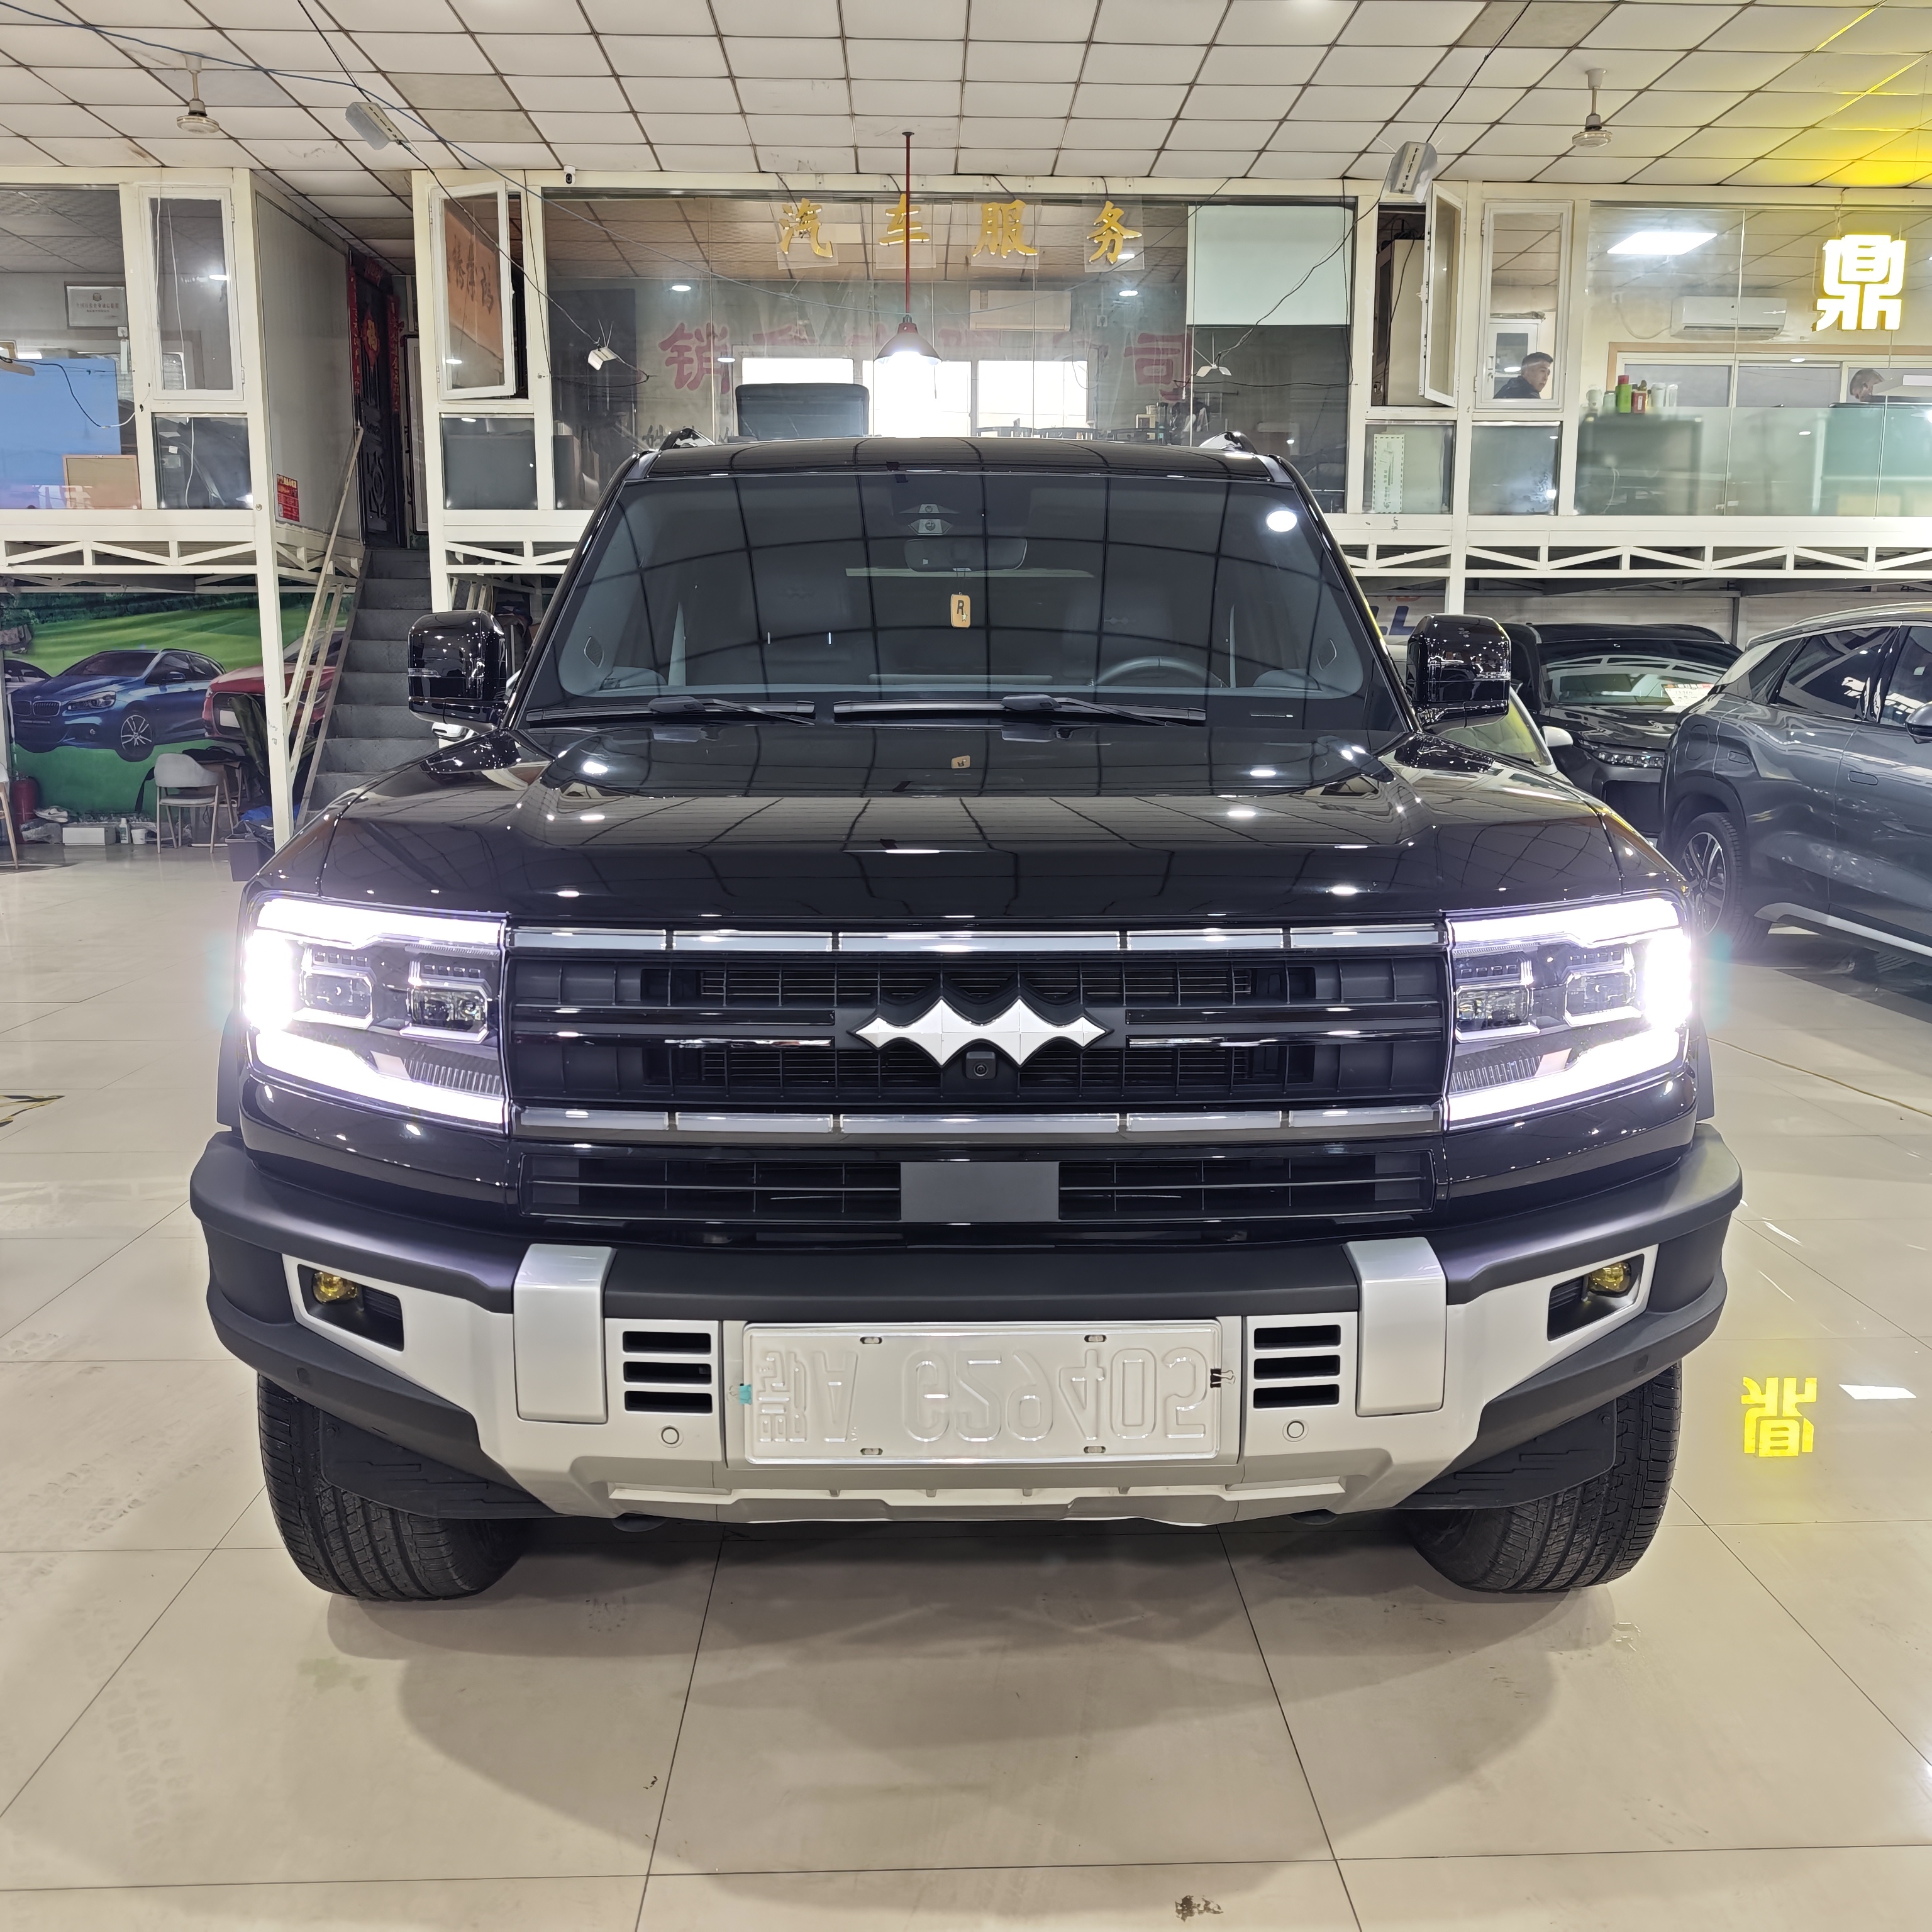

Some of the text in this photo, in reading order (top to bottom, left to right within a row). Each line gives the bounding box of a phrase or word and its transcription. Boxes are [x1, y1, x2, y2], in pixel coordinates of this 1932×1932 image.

[779, 192, 1143, 265] 汽车服务
[1815, 234, 1907, 331] 鼎
[957, 599, 965, 615] R
